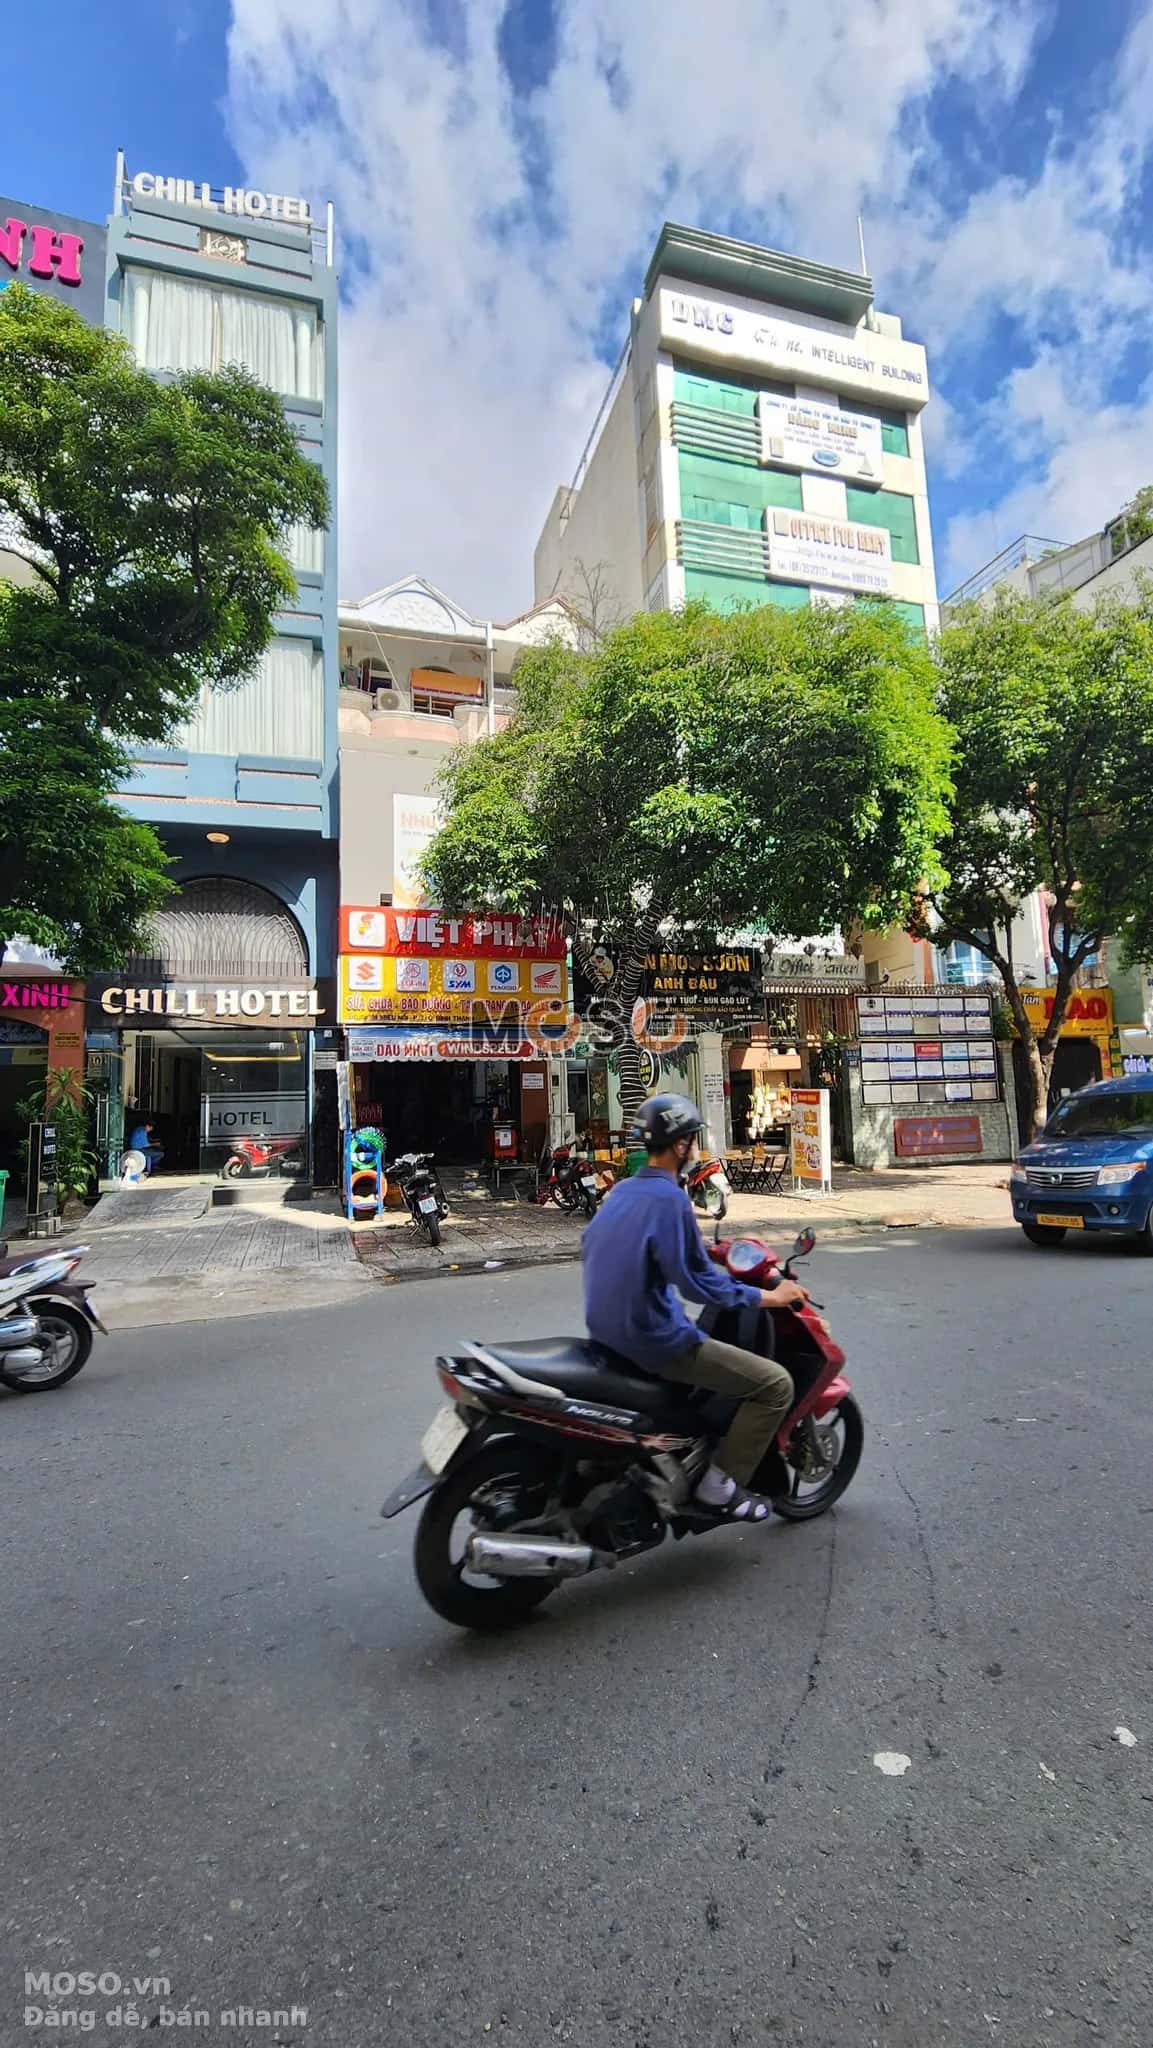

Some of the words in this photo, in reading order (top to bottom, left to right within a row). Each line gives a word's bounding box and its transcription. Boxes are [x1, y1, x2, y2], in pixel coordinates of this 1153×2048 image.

[133, 172, 219, 210] CHILL
[224, 187, 313, 225] HOTEL
[811, 346, 875, 374] INTELLIGENT
[882, 365, 922, 384] BUILDING
[395, 912, 463, 948] VIỆT
[447, 980, 471, 988] SYM
[654, 978, 684, 990] ANH
[100, 987, 206, 1016] CHILL
[215, 988, 326, 1017] HOTEL
[210, 1111, 273, 1127] HOTEL
